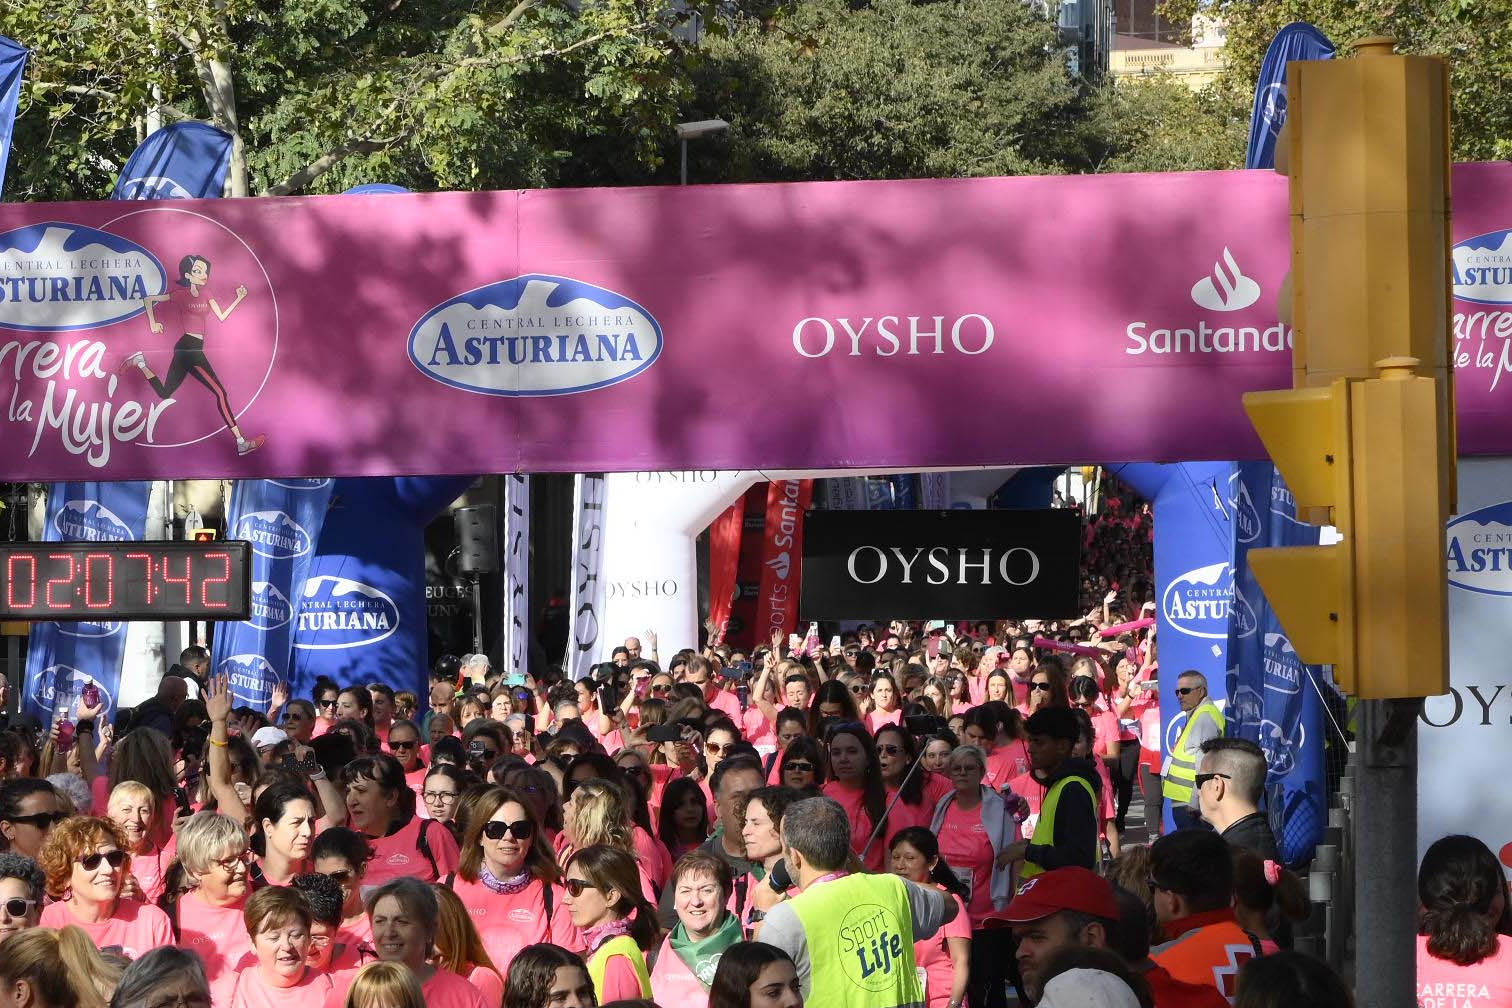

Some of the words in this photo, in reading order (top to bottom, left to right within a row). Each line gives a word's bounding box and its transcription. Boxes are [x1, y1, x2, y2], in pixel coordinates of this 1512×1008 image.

[70, 258, 142, 270] LECHERA
[466, 317, 545, 330] CENTRAL
[552, 314, 634, 327] LECHERA
[791, 313, 995, 358] OYSHO
[1125, 320, 1293, 356] Santand
[427, 321, 643, 367] ASTURIANA
[8, 381, 33, 423] la
[27, 373, 177, 468] Mujer
[7, 553, 230, 609] 02:07:42
[847, 545, 1040, 586] OYSHO
[1186, 588, 1229, 598] CENTRA
[298, 610, 391, 632] TURIANA
[840, 908, 889, 953] Sport
[856, 930, 904, 980] Life
